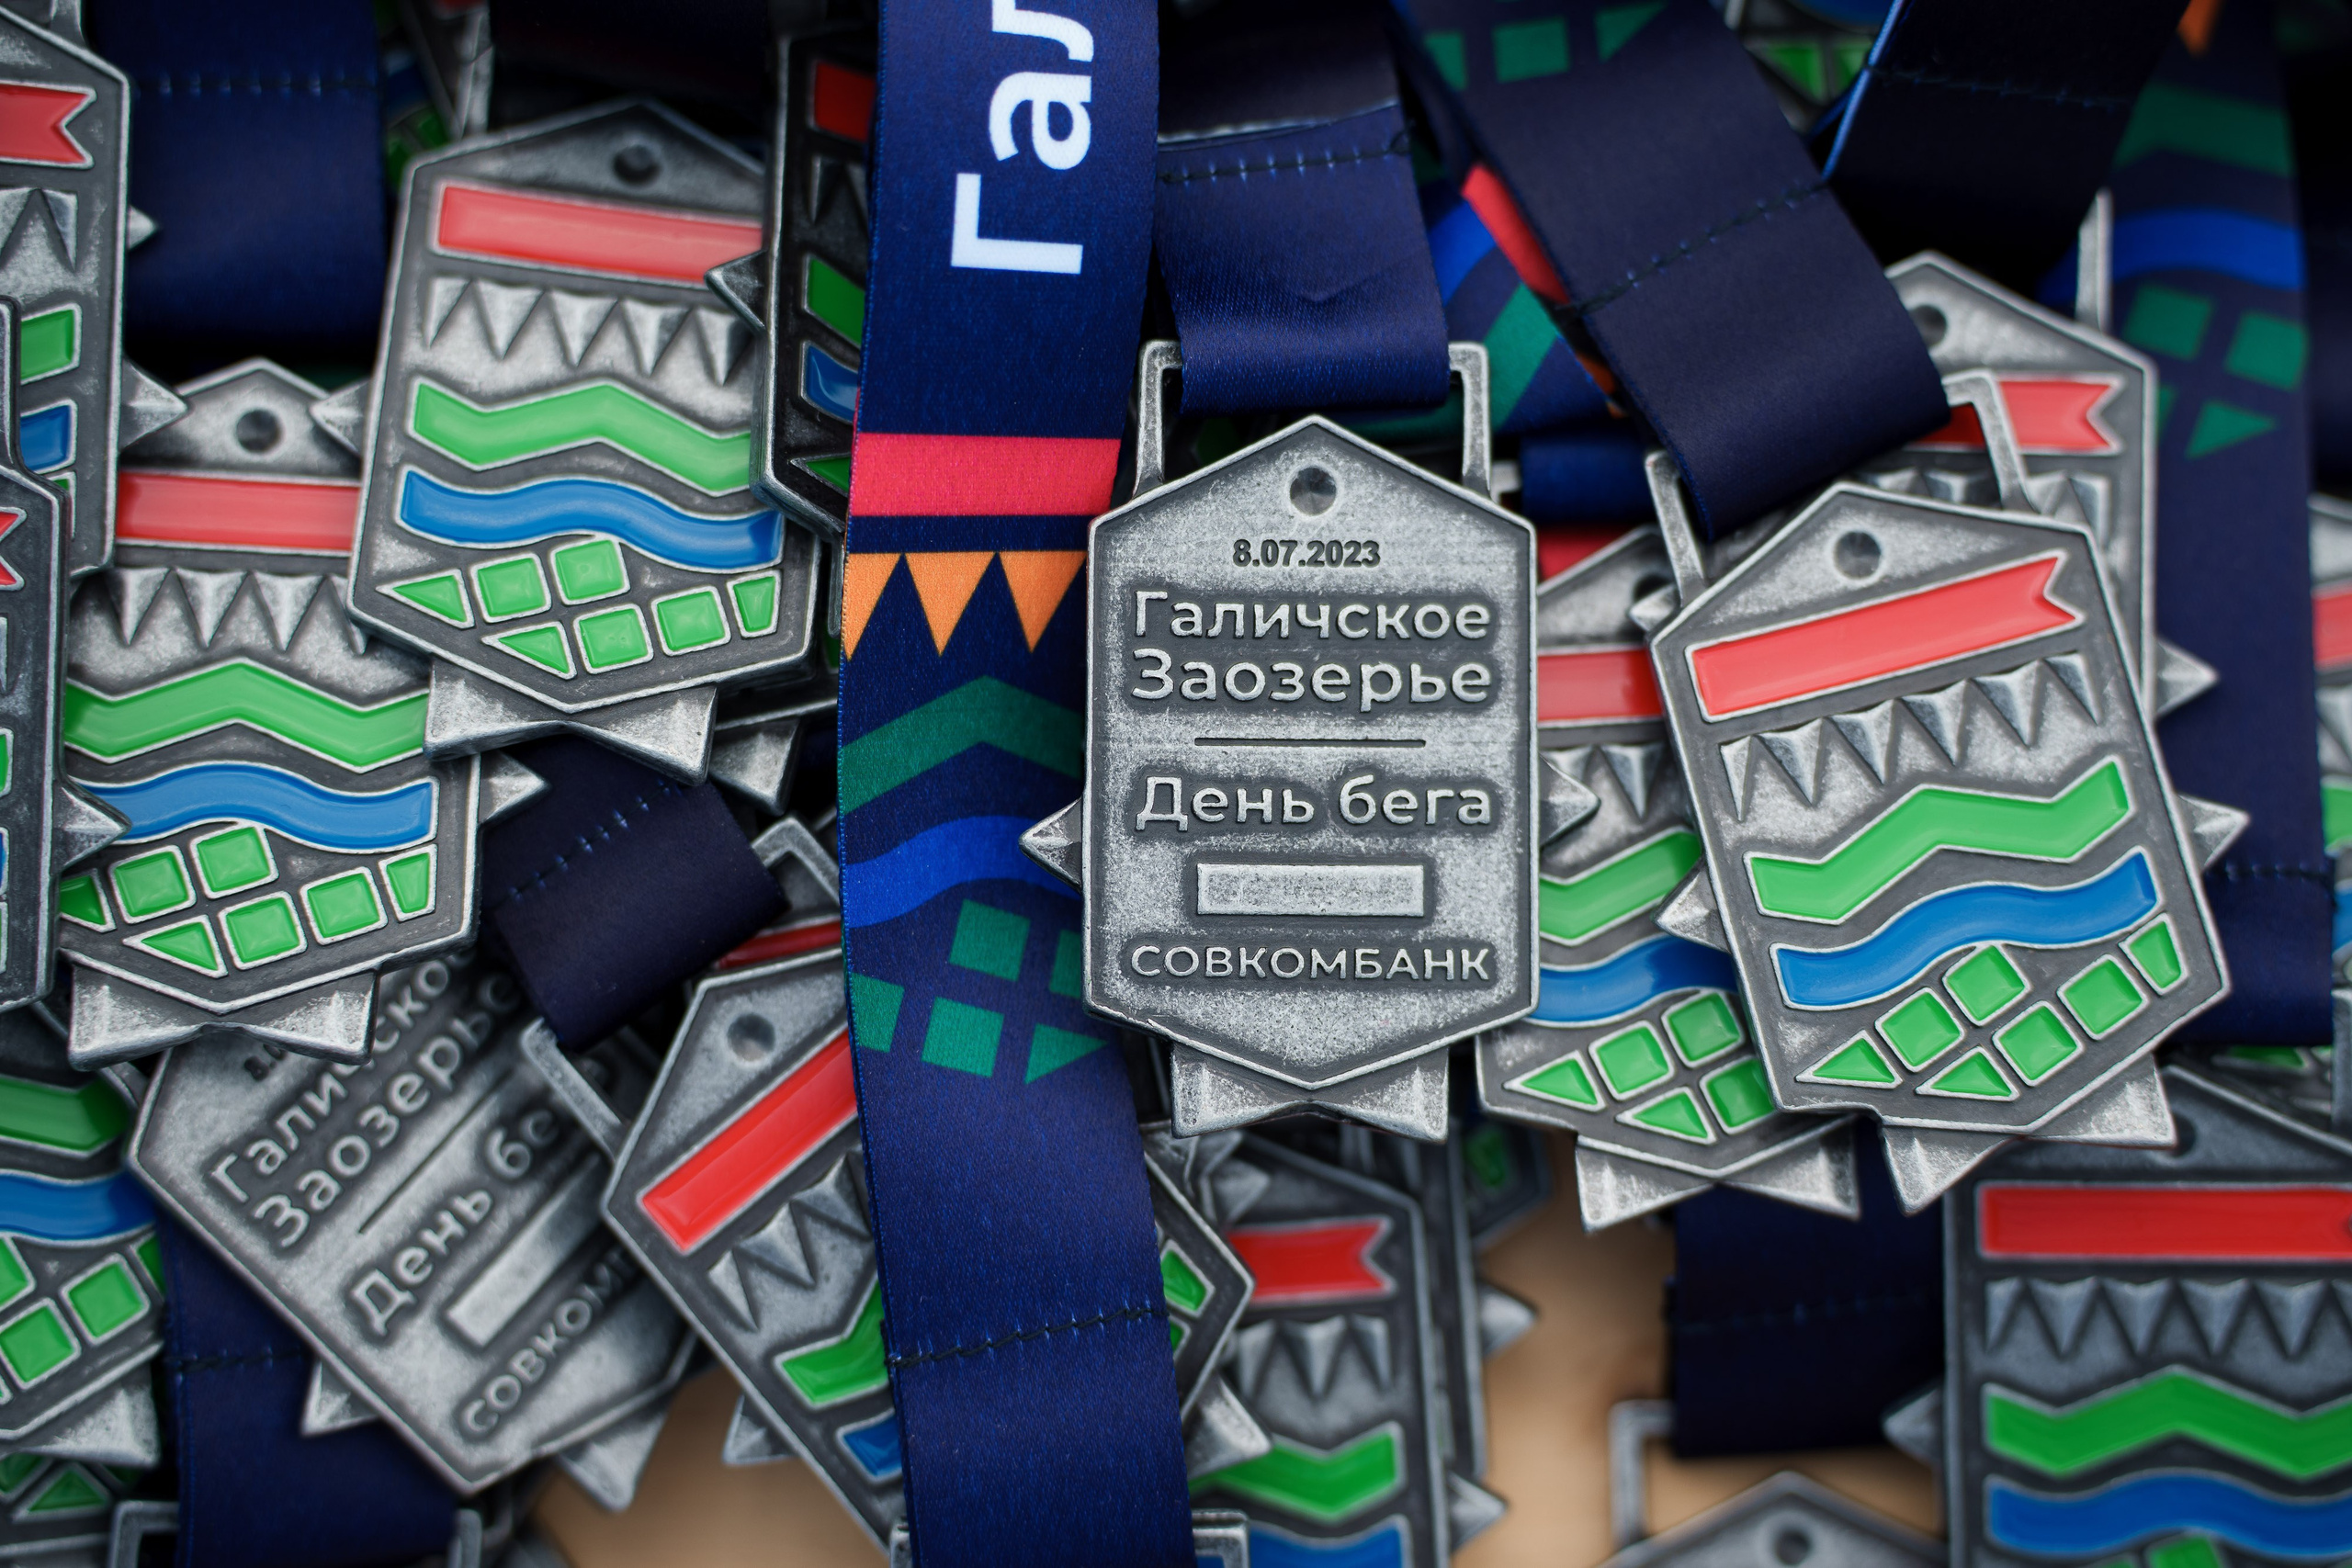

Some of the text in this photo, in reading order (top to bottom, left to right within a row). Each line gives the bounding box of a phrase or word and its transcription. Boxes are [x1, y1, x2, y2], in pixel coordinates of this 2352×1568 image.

[1232, 538, 1381, 568] 8.07.2023
[1133, 590, 1492, 640] Галичское
[1132, 648, 1492, 713] Заозерье
[1135, 774, 1492, 831] День бега
[1130, 944, 1490, 982] СОВКОМБАНК
[210, 950, 476, 1203] Галиско
[351, 1189, 492, 1336] День
